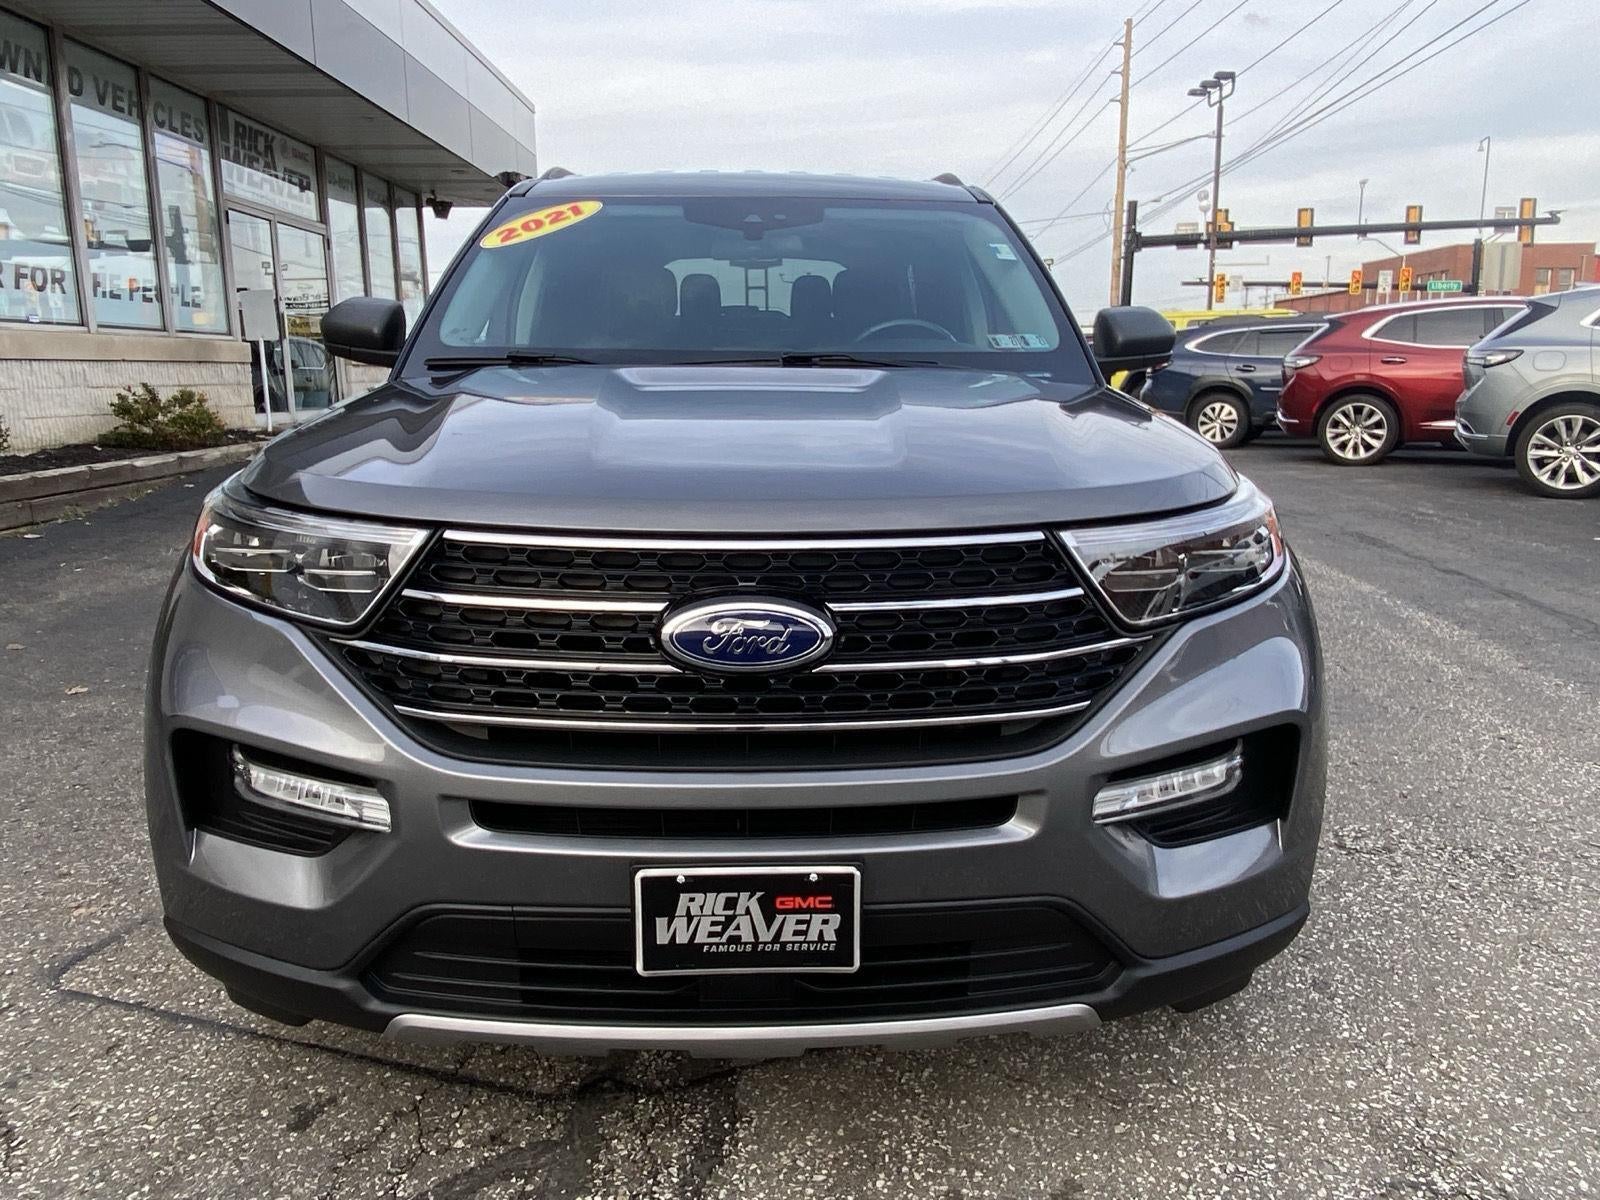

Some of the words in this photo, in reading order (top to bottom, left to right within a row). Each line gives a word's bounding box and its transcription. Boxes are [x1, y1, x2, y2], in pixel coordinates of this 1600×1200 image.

[93, 73, 204, 143] VEHCLES
[234, 119, 276, 159] RICK
[497, 203, 584, 243] 2021
[14, 264, 66, 294] FOR
[1431, 280, 1458, 291] Liberty
[702, 617, 793, 655] Ford
[675, 892, 765, 916] RICK
[775, 896, 834, 909] GMC
[655, 913, 842, 945] WEAVER
[703, 944, 752, 953] FAMOUS
[757, 943, 780, 952] FOR
[786, 942, 837, 951] SERVICE
